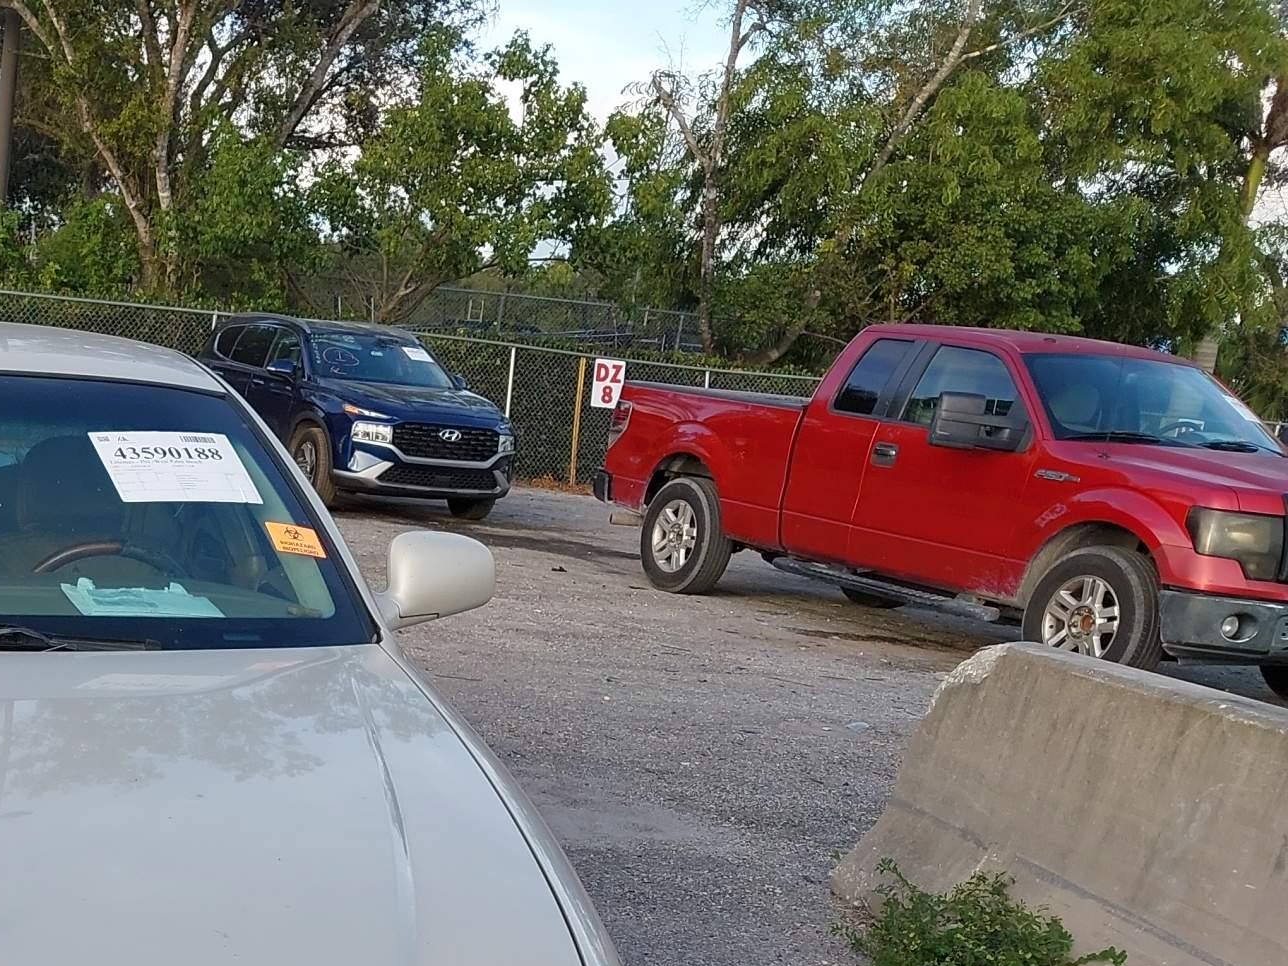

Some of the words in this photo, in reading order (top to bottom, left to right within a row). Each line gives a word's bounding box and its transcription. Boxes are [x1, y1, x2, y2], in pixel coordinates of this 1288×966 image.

[595, 362, 624, 383] DZ
[601, 385, 613, 404] 8
[113, 446, 223, 461] 43590188
